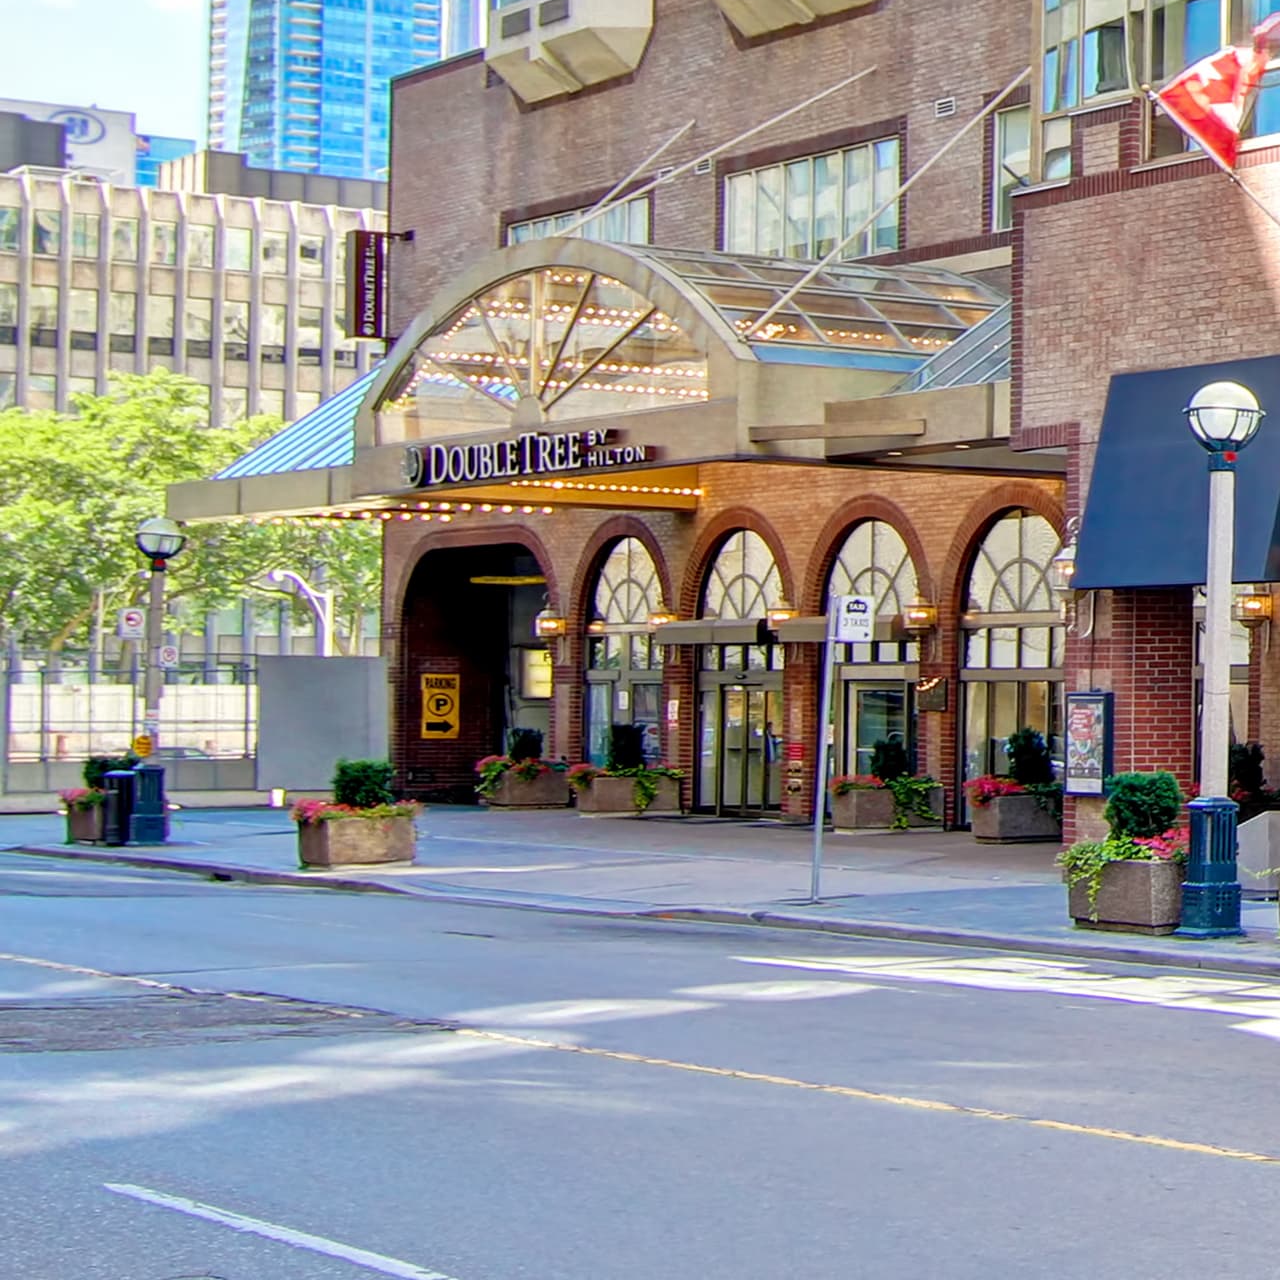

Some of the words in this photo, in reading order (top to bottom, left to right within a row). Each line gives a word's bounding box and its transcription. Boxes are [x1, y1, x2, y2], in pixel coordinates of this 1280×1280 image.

[429, 432, 583, 484] DOUBLETREE
[587, 428, 608, 446] BY
[587, 446, 647, 467] HILTON
[425, 677, 457, 690] PARKING
[435, 698, 448, 711] P
